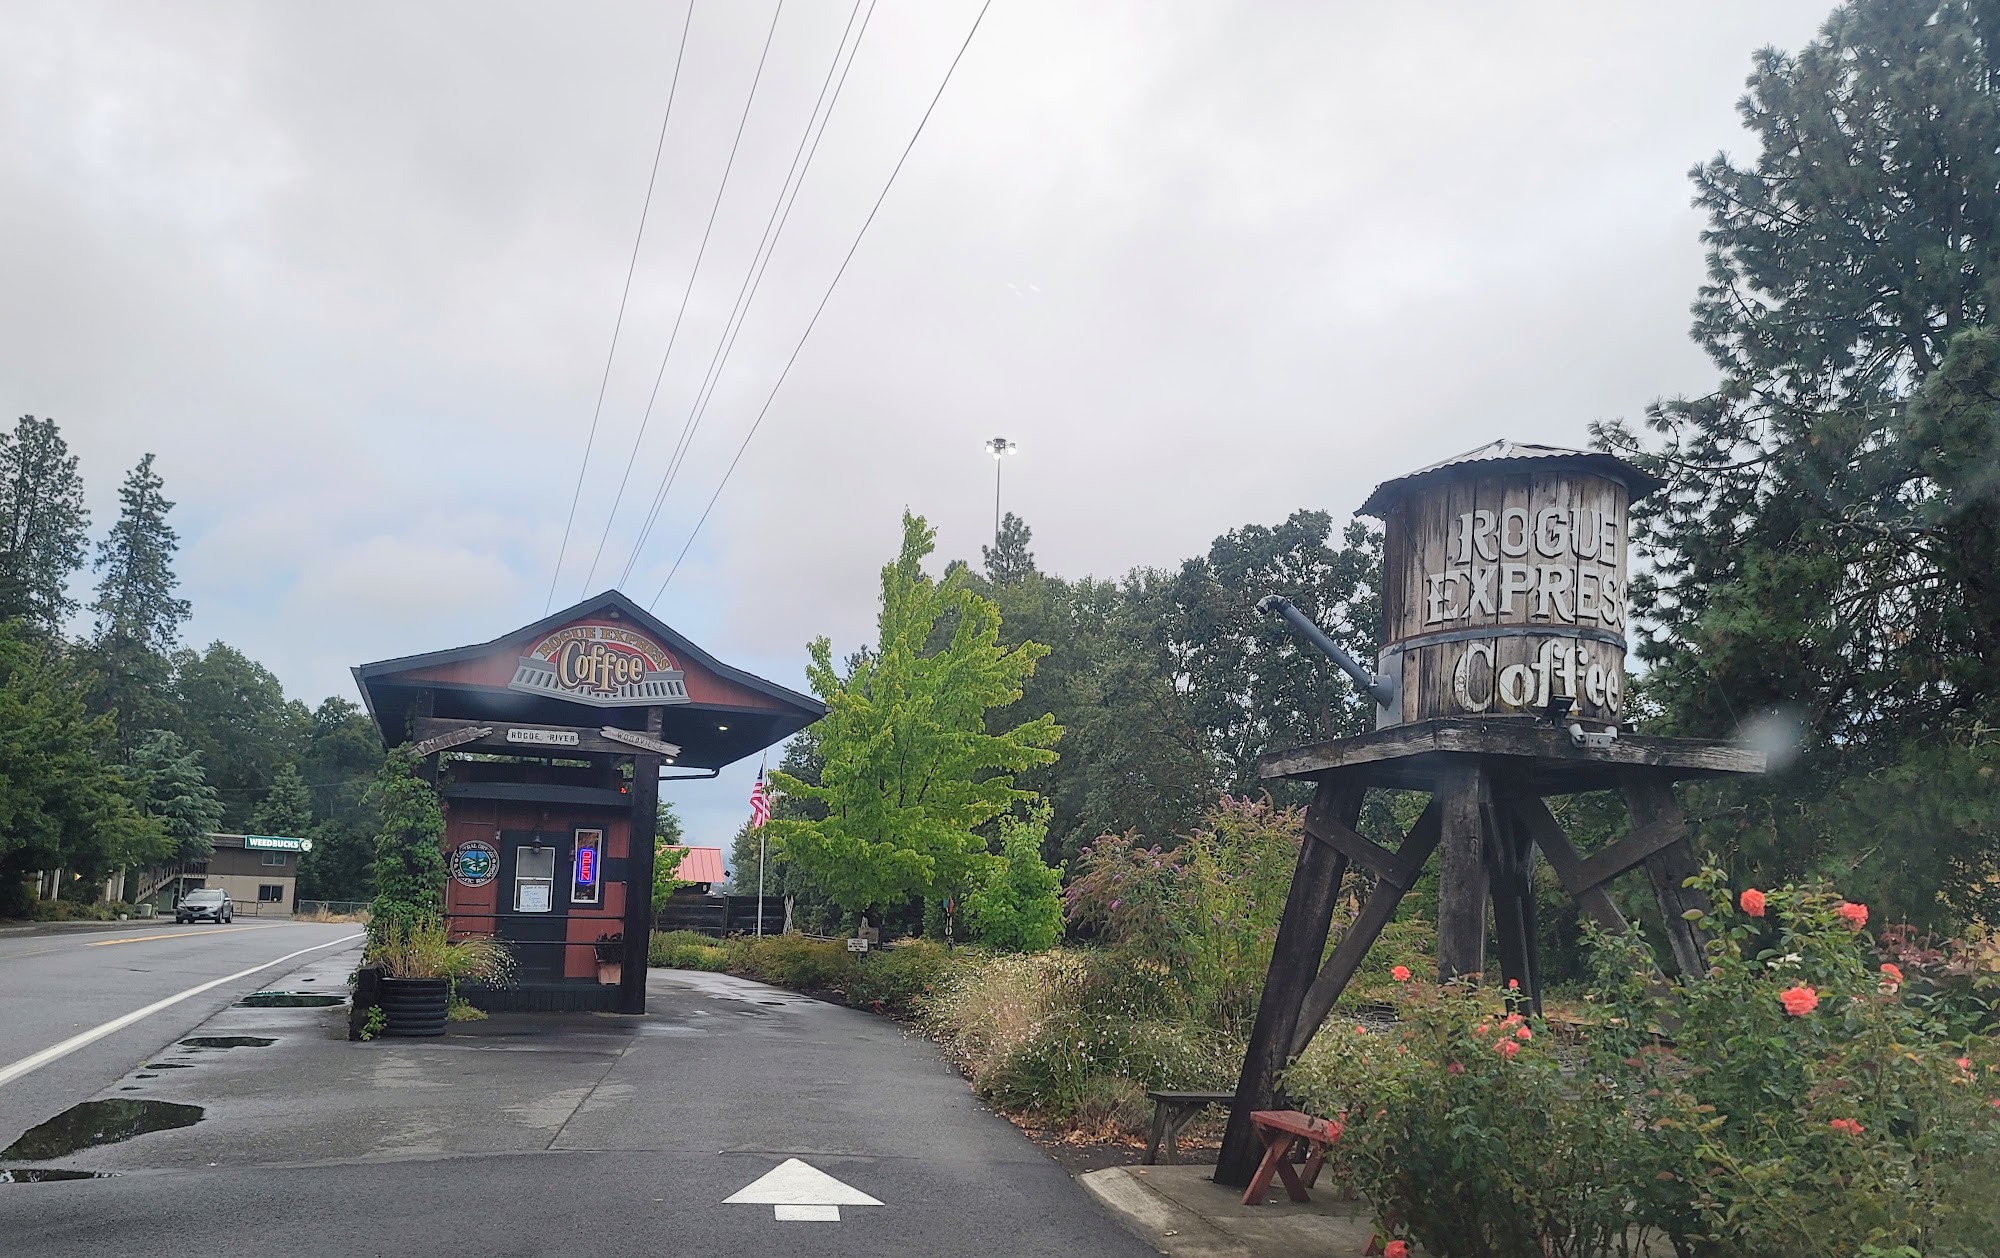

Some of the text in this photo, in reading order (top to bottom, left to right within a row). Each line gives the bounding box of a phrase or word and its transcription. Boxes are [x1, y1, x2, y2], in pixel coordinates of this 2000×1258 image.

[1454, 507, 1618, 567] ROGUE
[1424, 562, 1628, 630] EXPRESS
[536, 627, 671, 671] ROGUE EXPRESS
[558, 639, 644, 692] Coffee
[1453, 637, 1619, 713] Coffee
[511, 731, 576, 743] ROGUE RIVER
[249, 837, 299, 849] WEEDBUCKS
[580, 851, 592, 881] OPEN
